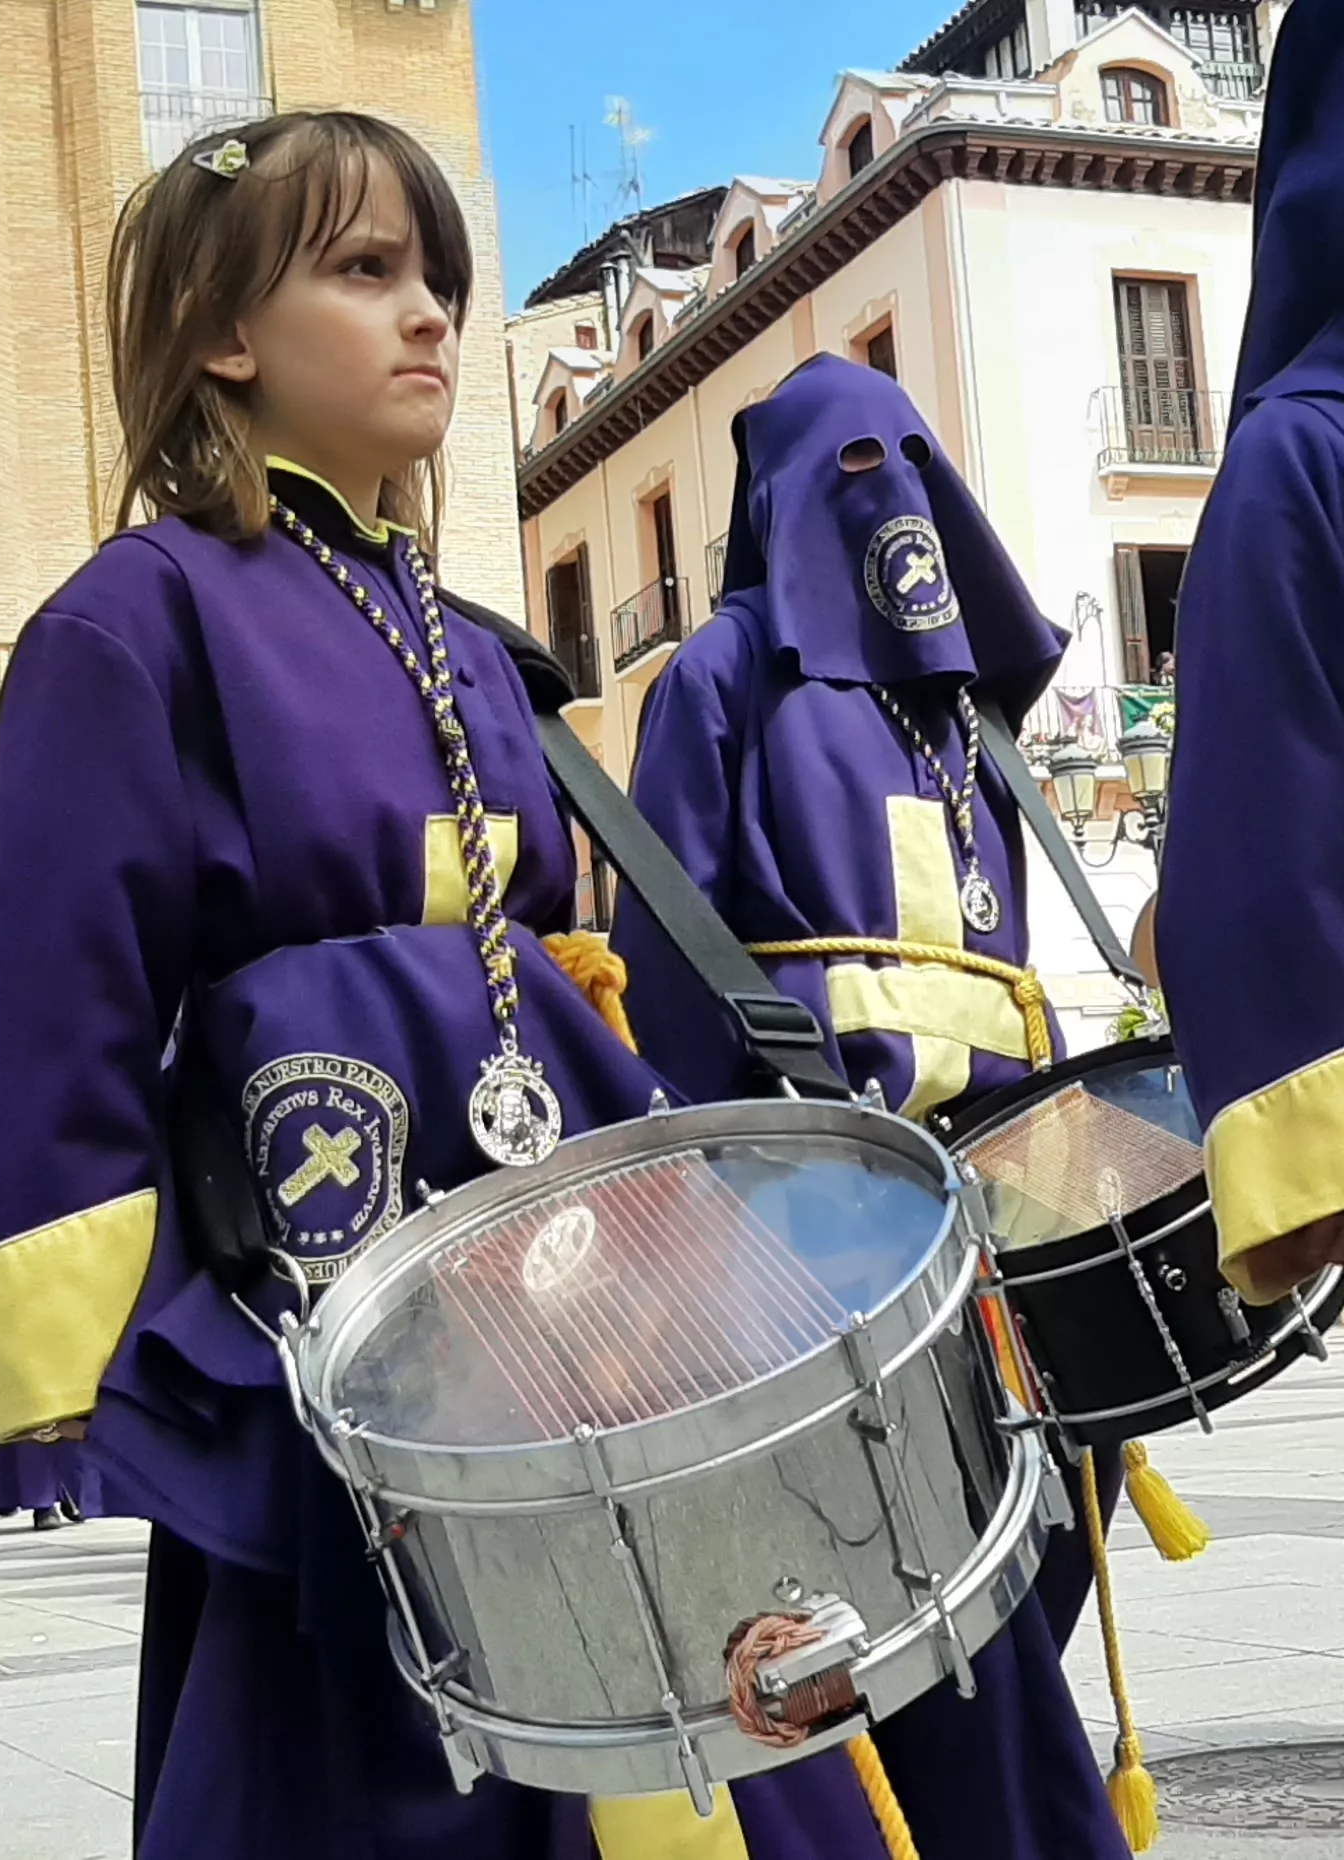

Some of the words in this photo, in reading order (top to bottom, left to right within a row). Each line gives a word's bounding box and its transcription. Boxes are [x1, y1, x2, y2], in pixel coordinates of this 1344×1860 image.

[254, 1058, 342, 1095] NUESTRO
[346, 1062, 401, 1109] PADRE
[325, 1085, 367, 1122] Rex
